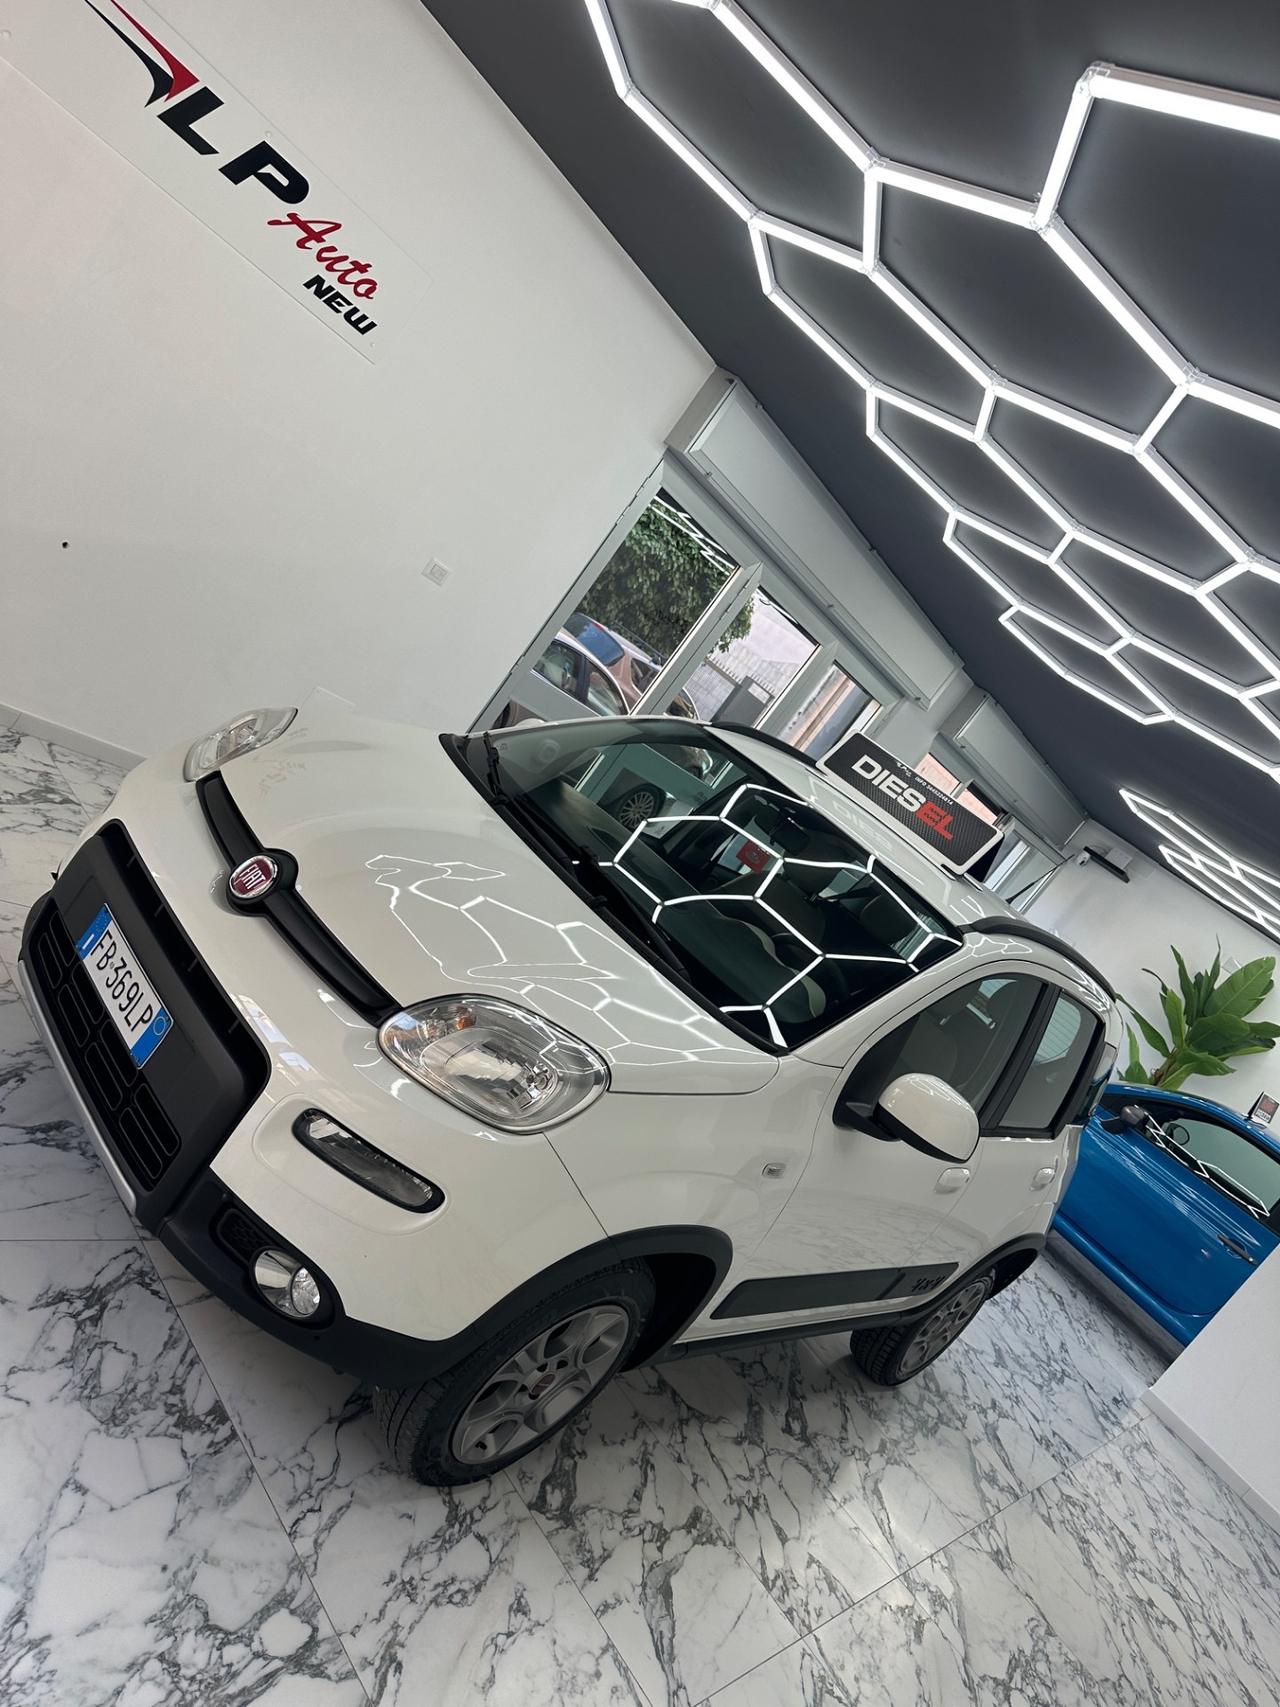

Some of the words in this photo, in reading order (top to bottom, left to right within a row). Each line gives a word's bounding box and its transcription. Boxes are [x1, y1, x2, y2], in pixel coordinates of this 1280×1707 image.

[156, 86, 309, 205] LP
[267, 212, 378, 300] Auto
[302, 274, 378, 336] NEW
[851, 754, 954, 841] DIESEL
[240, 863, 266, 890] FIAT
